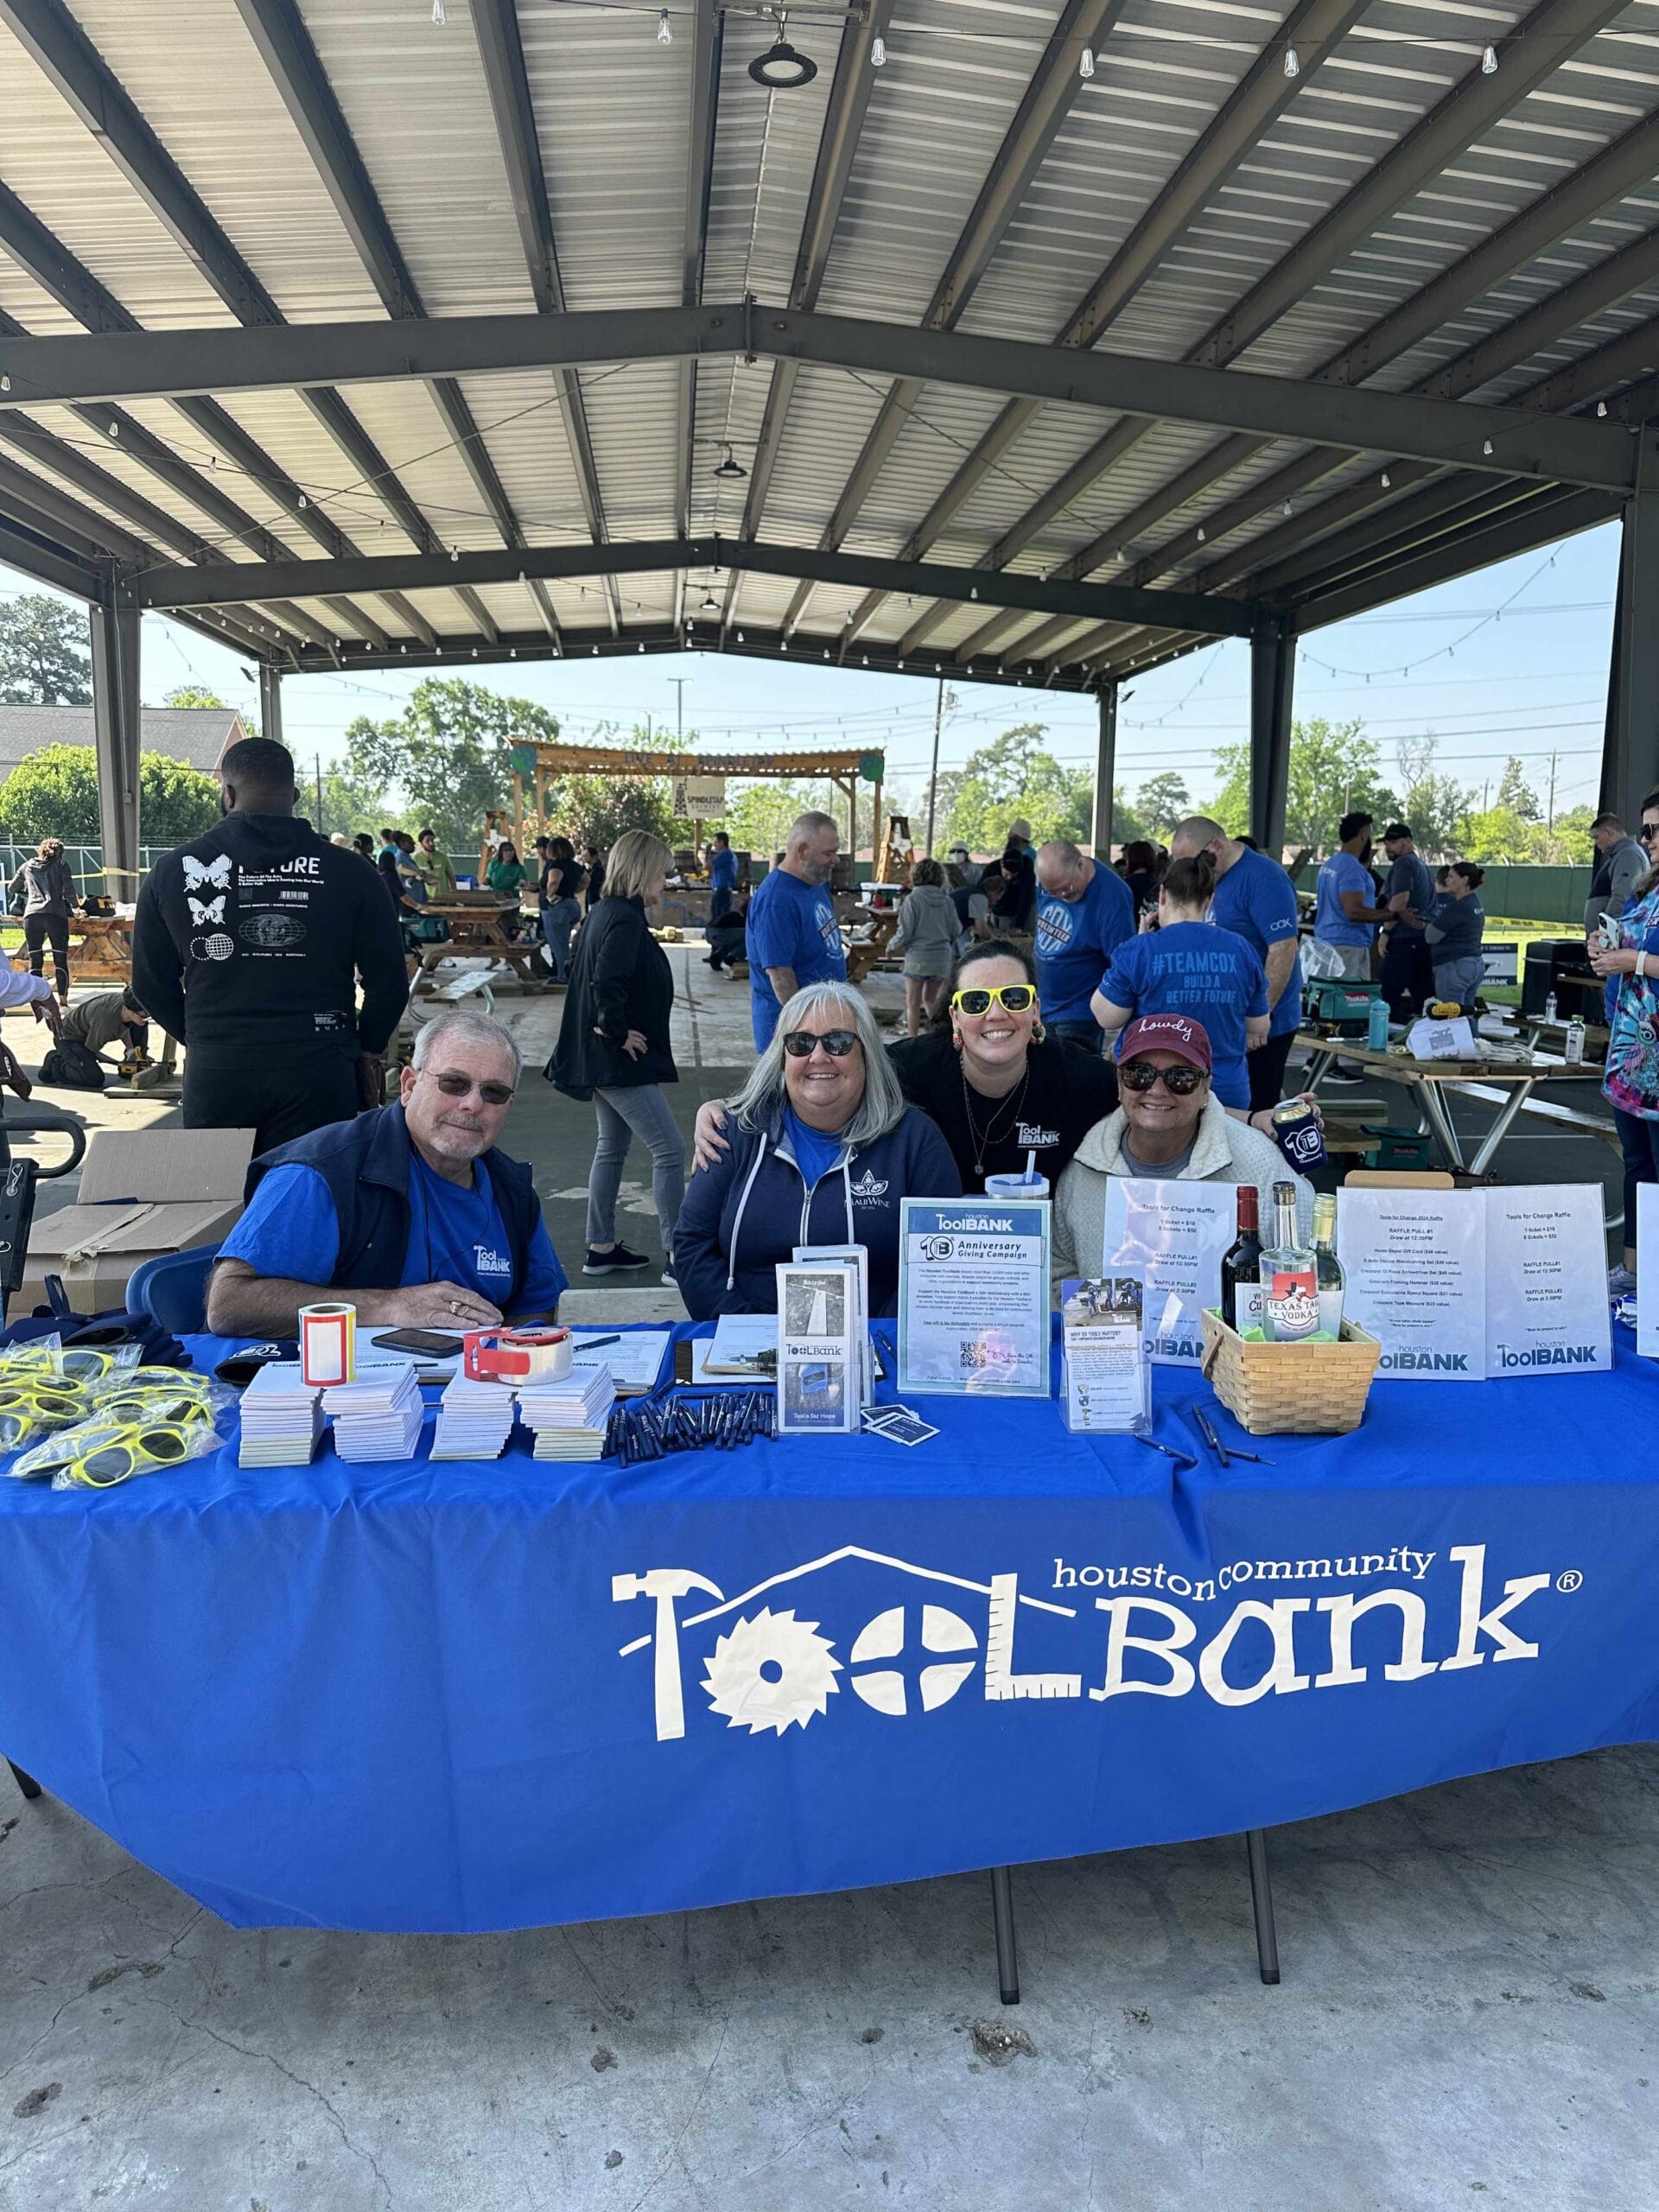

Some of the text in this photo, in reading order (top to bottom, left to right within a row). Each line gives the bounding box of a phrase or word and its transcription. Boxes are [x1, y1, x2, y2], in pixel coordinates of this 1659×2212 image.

[238, 856, 321, 874] URE
[1270, 918, 1293, 931] COX
[1152, 951, 1237, 976] #TEAMCOX
[1184, 975, 1220, 988] BUILD A
[1166, 990, 1236, 1004] BETTER FUTURE
[1139, 1019, 1192, 1042] howdy
[1015, 1122, 1040, 1140] Tool
[1023, 1133, 1060, 1144] BANK
[936, 1213, 1014, 1231] ToolBANK
[958, 1241, 1021, 1251] Anniversary
[473, 1245, 496, 1266] Tool
[480, 1260, 510, 1272] BANK
[1268, 1301, 1302, 1310] TEXAS
[1281, 1310, 1313, 1320] VODKA
[1160, 1331, 1194, 1340] houston
[1398, 1344, 1433, 1353] houston
[1379, 1353, 1469, 1370] olBANK
[1497, 1344, 1597, 1368] ToolBANK
[1052, 1546, 1436, 1601] houston community
